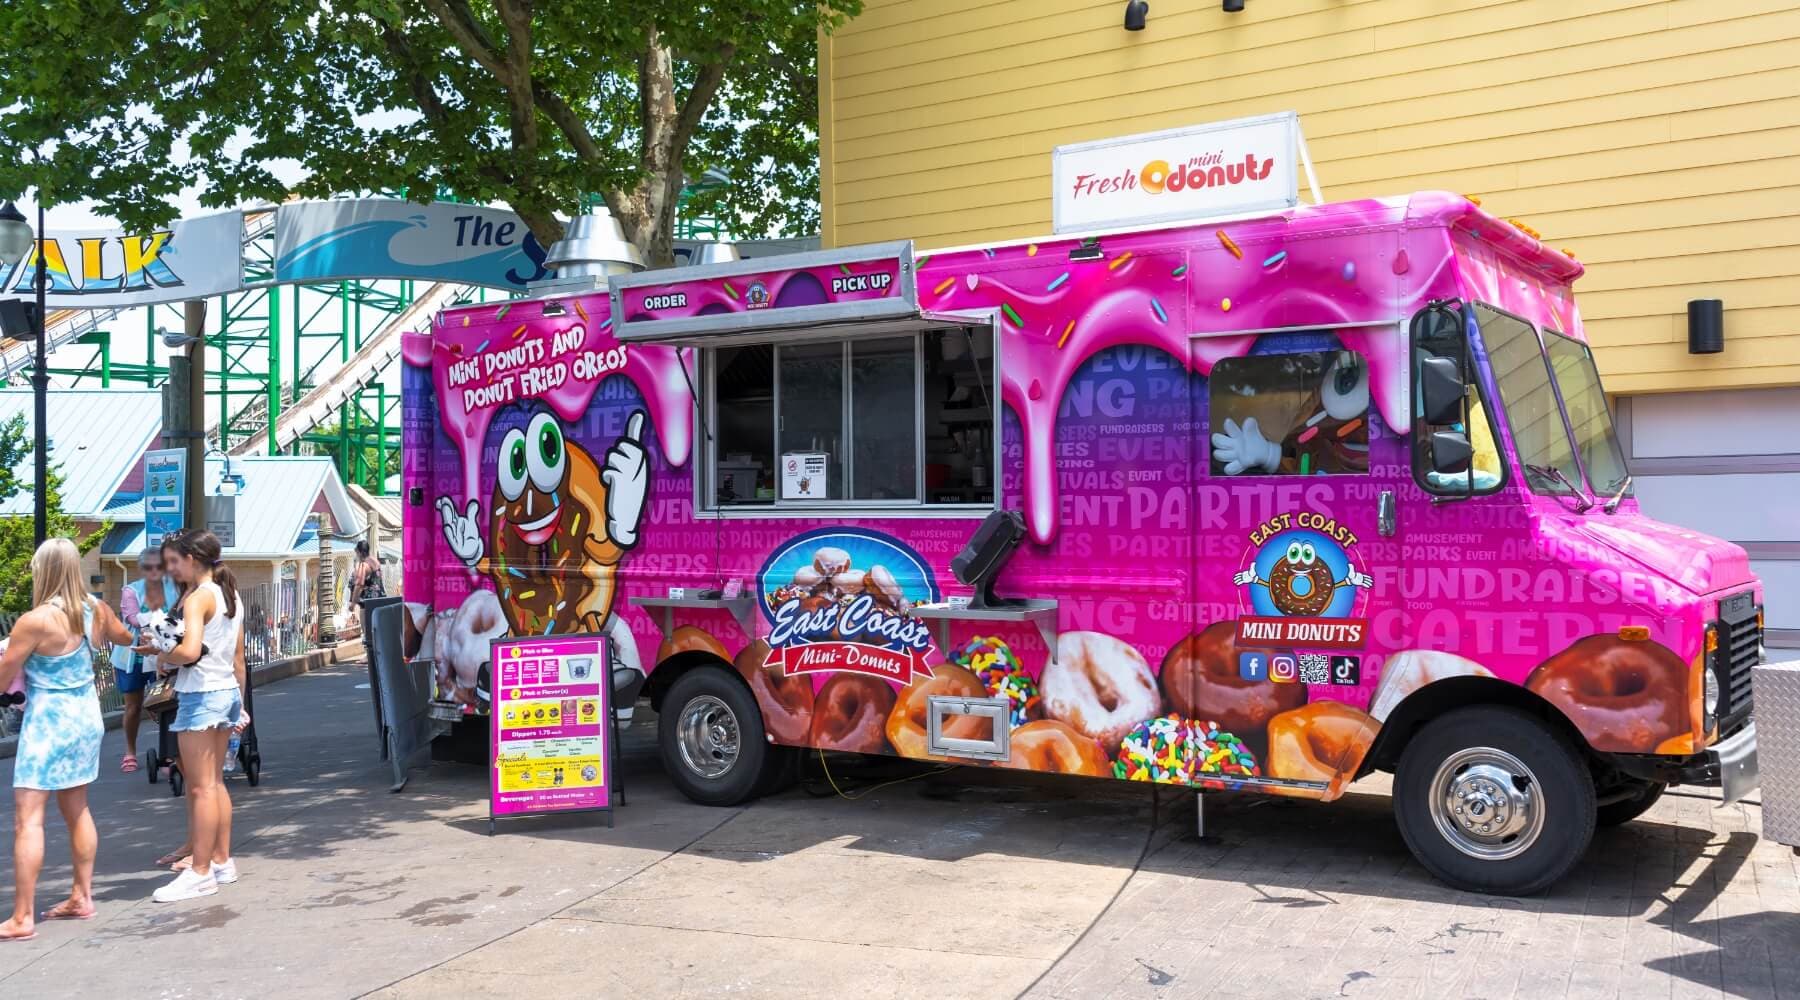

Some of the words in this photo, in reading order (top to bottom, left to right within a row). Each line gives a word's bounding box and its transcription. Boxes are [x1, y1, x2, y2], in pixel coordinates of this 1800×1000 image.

[1188, 149, 1224, 168] mini
[1166, 153, 1274, 193] donuts
[1073, 168, 1137, 200] Fresh
[453, 215, 516, 247] The
[832, 275, 868, 293] PICK
[870, 273, 891, 289] UP
[644, 294, 687, 310] ORDER
[485, 337, 546, 373] DONUTS
[550, 326, 586, 352] AND
[464, 382, 515, 413] DONUT
[1100, 423, 1165, 435] FUNDRAISERS
[1128, 470, 1163, 482] EVENT
[1127, 484, 1335, 530] PARTIES
[910, 530, 963, 540] AMUSEMENT
[1249, 513, 1292, 547] EAST
[1297, 512, 1358, 548] COAST
[1405, 533, 1484, 544] AMUSEMENT
[907, 540, 949, 554] PARKS
[1402, 545, 1462, 561] PARKS
[1466, 550, 1497, 561] EVENT
[1407, 601, 1433, 610] FOOD
[769, 599, 840, 646] East
[838, 595, 931, 648] Coast
[1242, 621, 1283, 640] MINI
[1287, 623, 1362, 643] DONUTS
